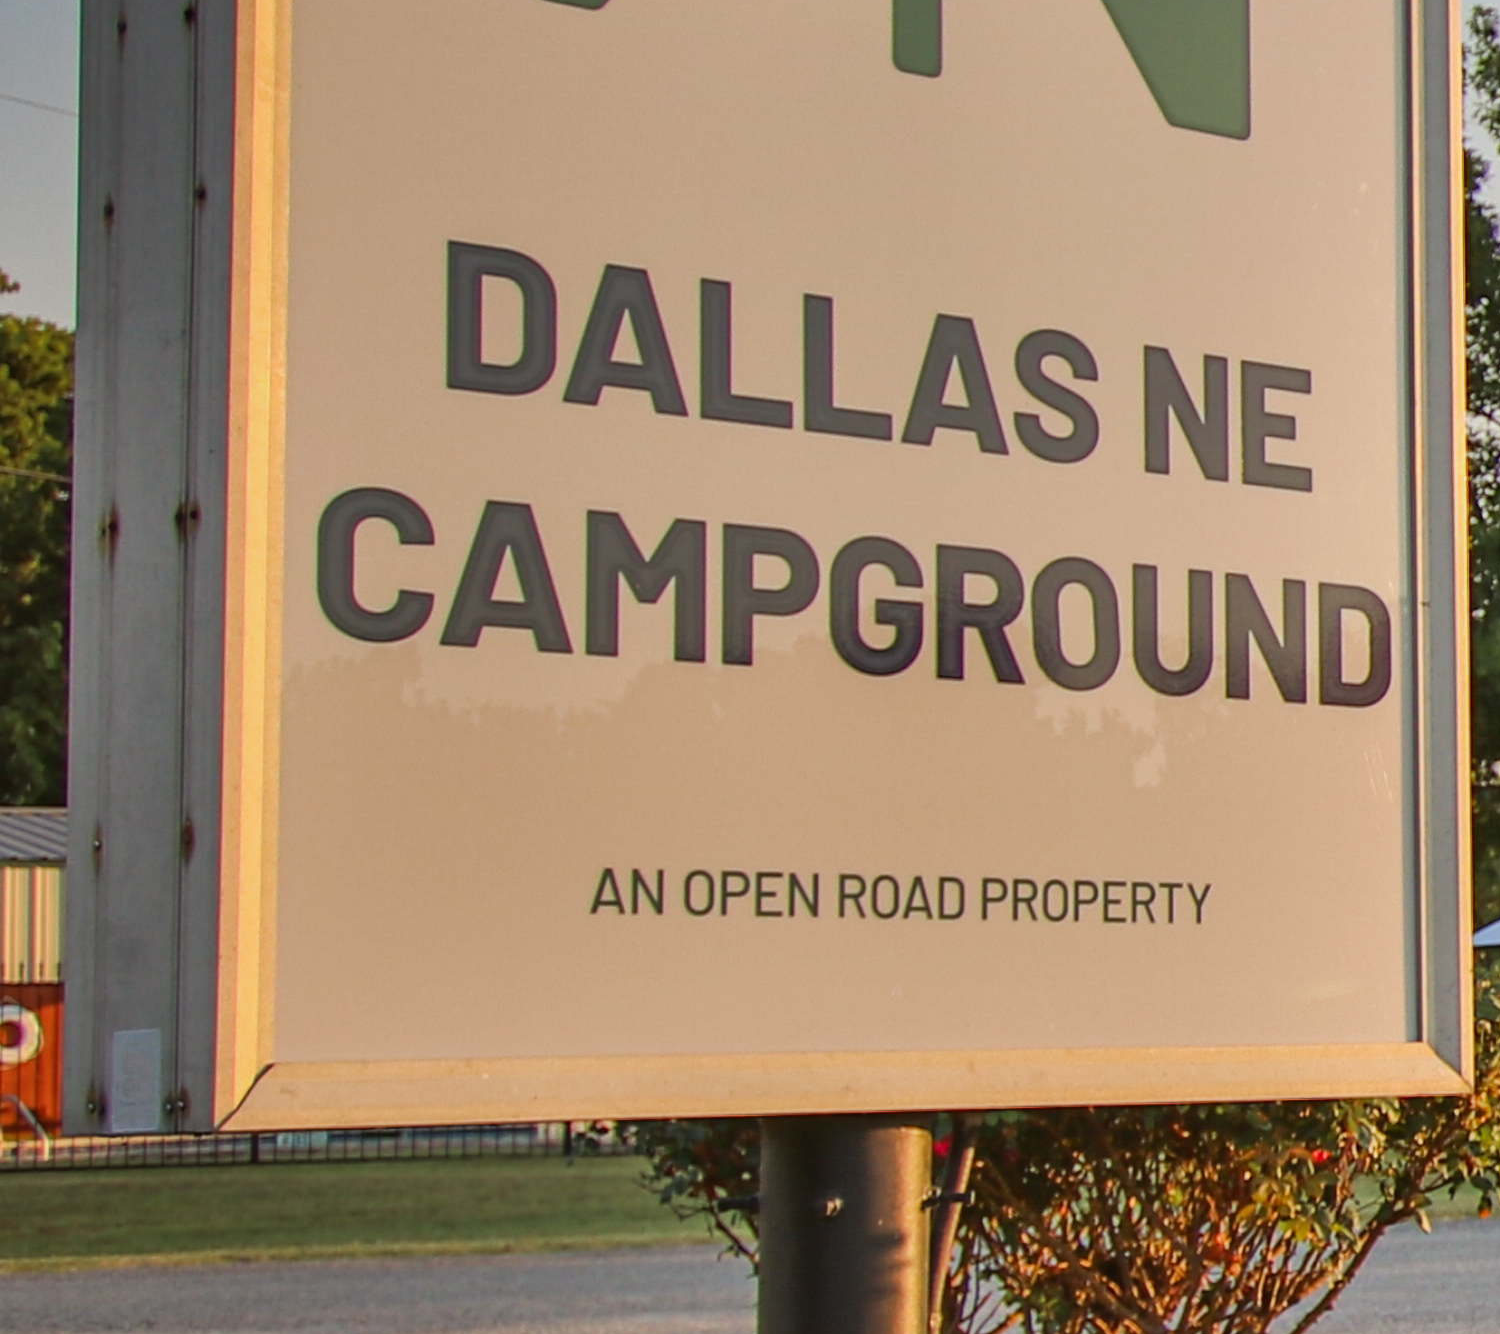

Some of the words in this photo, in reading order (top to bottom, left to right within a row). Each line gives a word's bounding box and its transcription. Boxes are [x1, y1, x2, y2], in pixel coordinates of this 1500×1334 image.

[445, 239, 1100, 464] DALLAS
[1143, 344, 1313, 493] NE
[316, 486, 1392, 709] CAMPGROUND
[589, 867, 665, 916] AN
[683, 869, 820, 919] OPEN
[838, 873, 966, 921] ROAD
[981, 877, 1212, 925] PROPERTY
